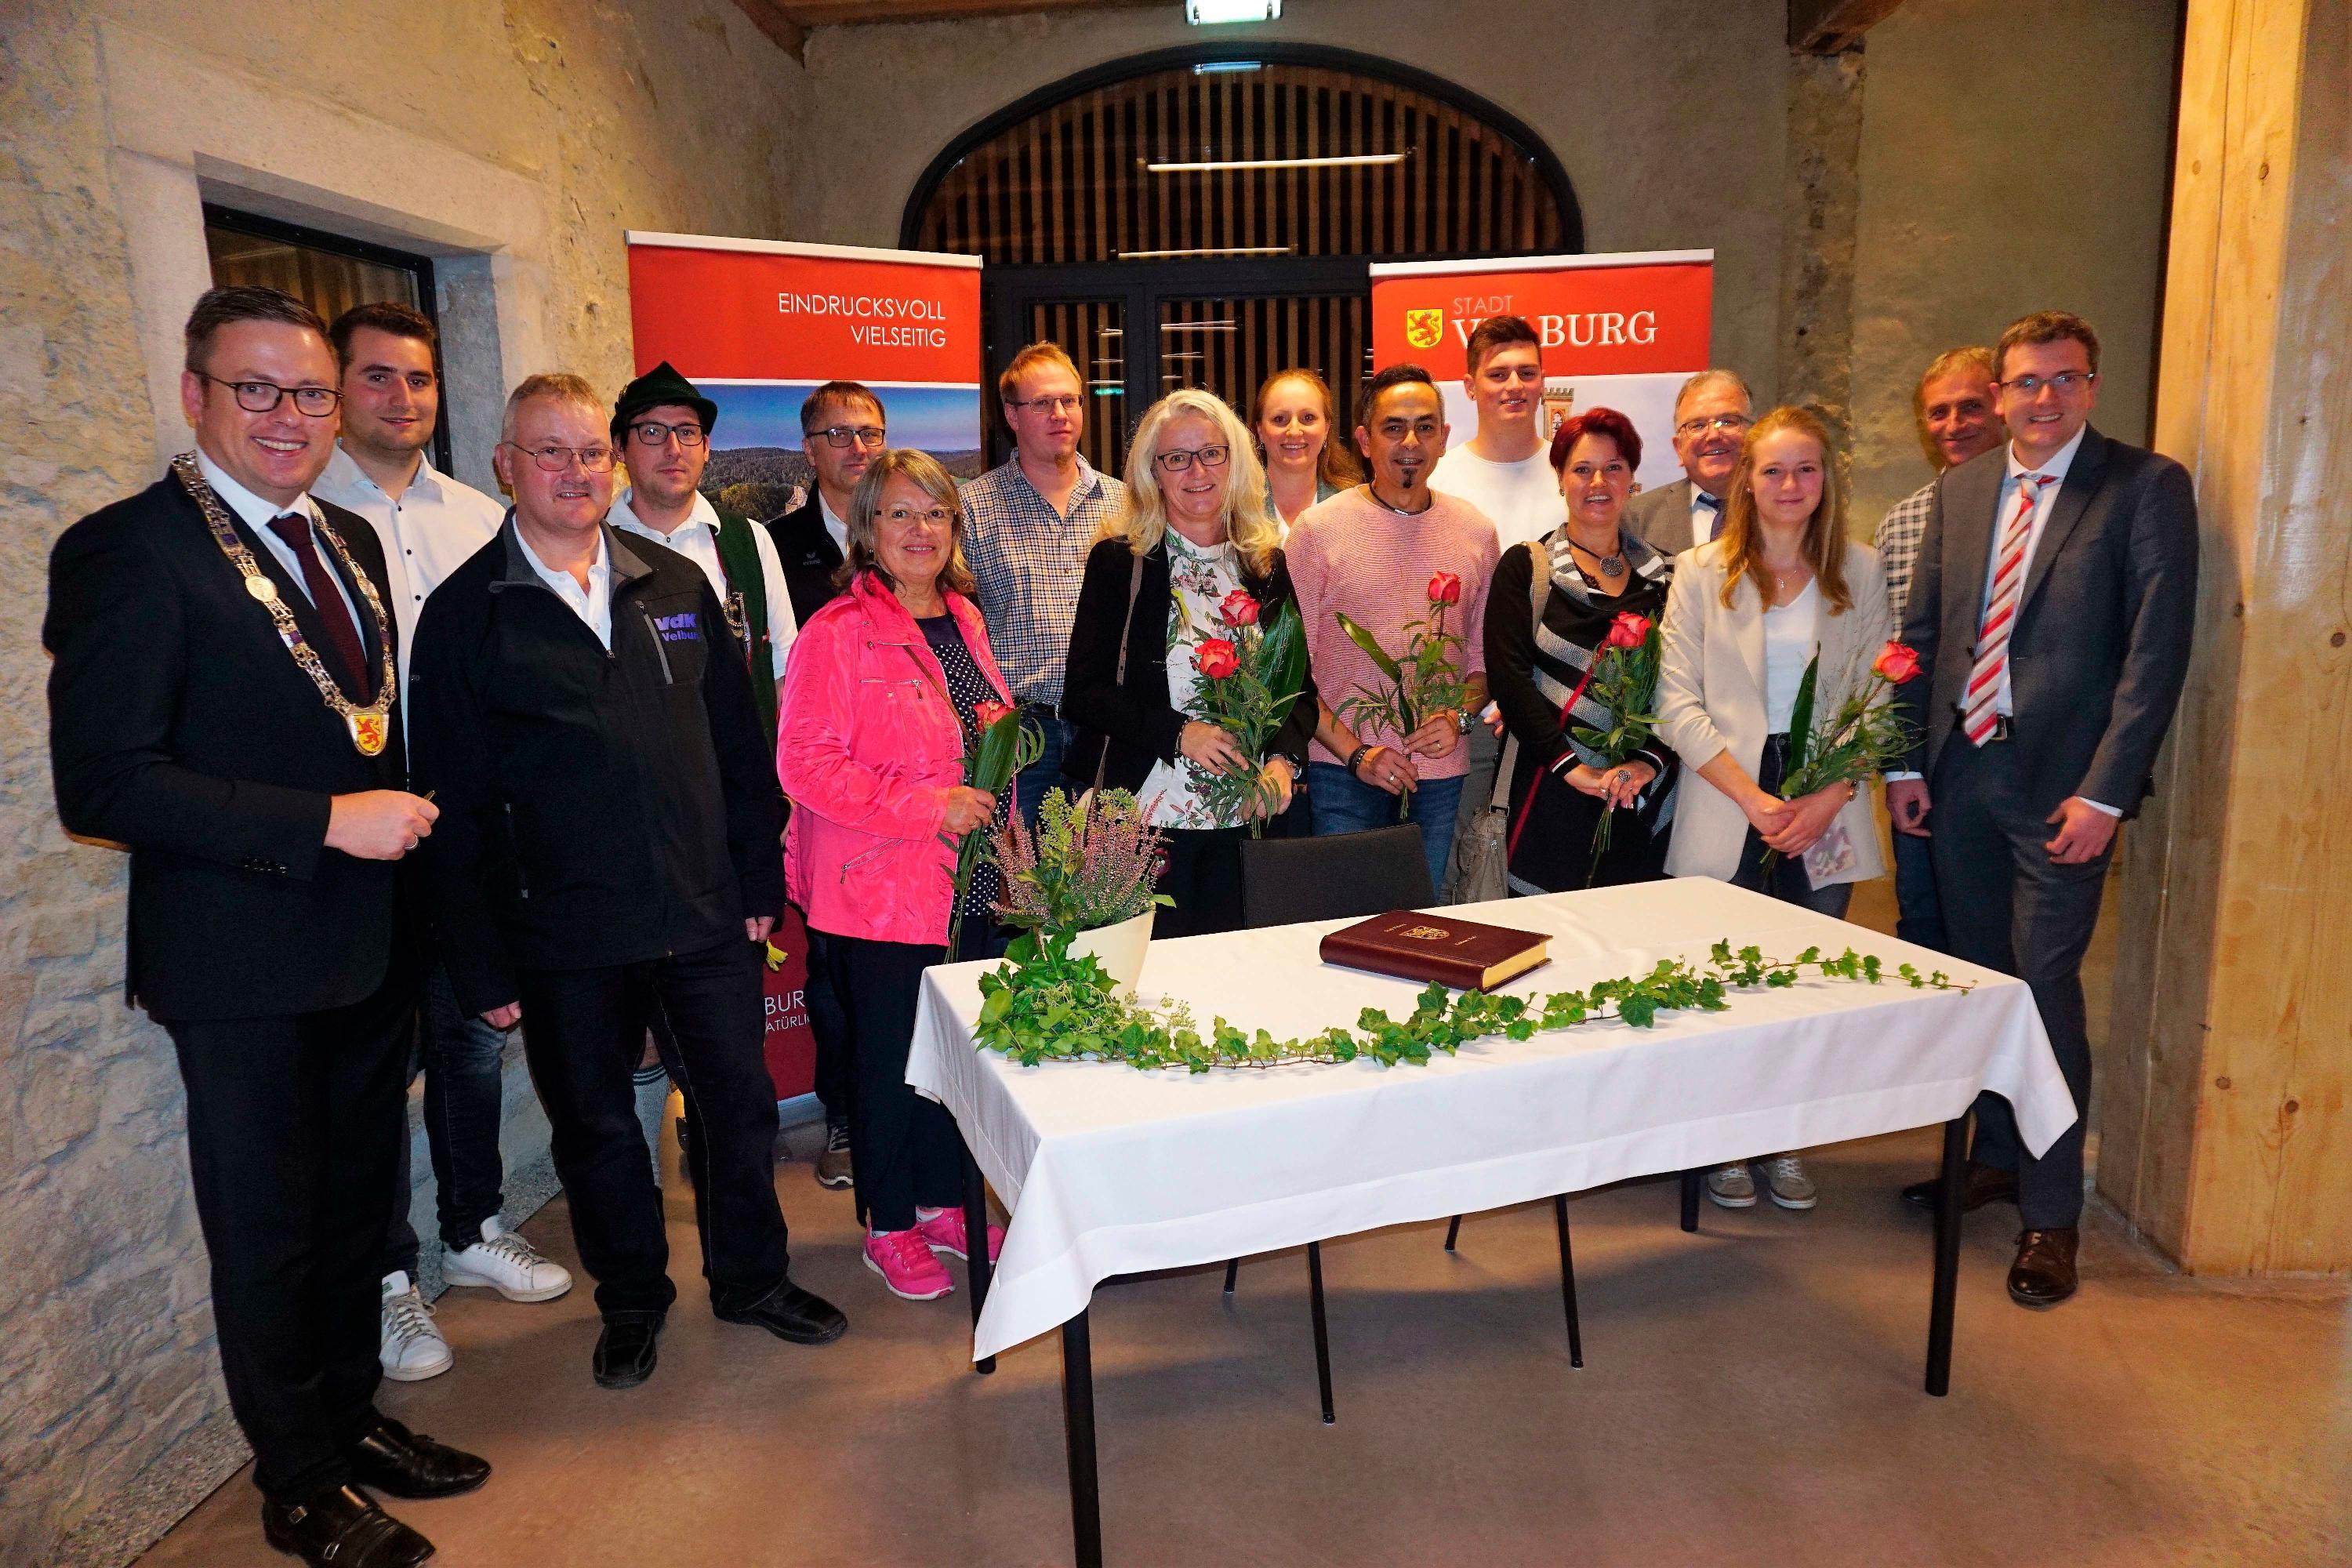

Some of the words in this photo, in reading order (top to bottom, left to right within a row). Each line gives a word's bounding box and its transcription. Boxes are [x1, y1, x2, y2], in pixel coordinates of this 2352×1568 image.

[778, 292, 946, 321] EINDRUCKSVOLL
[1453, 295, 1514, 314] STADT
[850, 325, 946, 347] VIELSEITIG
[1451, 310, 1659, 350] VBURG
[764, 989, 805, 1015] BUR
[765, 1014, 810, 1033] ATÜRLI
